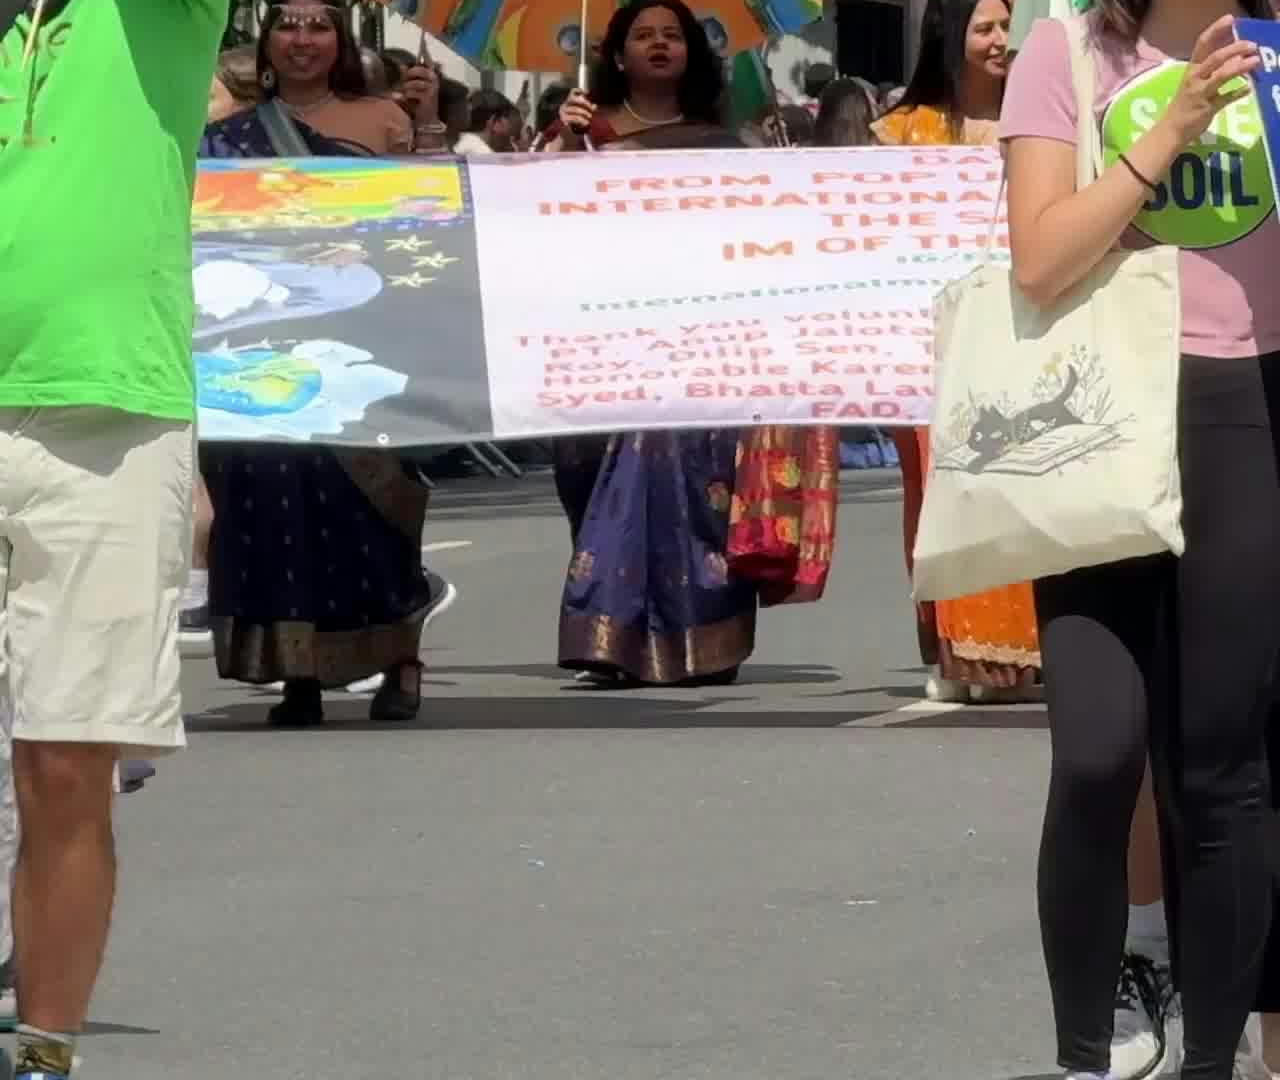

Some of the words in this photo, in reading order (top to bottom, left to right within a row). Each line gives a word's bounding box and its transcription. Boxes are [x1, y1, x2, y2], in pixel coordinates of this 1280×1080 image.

[595, 173, 772, 193] FROM
[537, 190, 1006, 216] INTERNATIONA
[822, 212, 938, 227] THE
[722, 238, 794, 261] IM
[815, 235, 892, 253] OF
[514, 326, 657, 348] Thank
[680, 317, 761, 333] you
[647, 330, 769, 352] Anup
[667, 342, 774, 363] Dilip
[544, 362, 788, 386] Honorable
[684, 381, 844, 398] Bhatta
